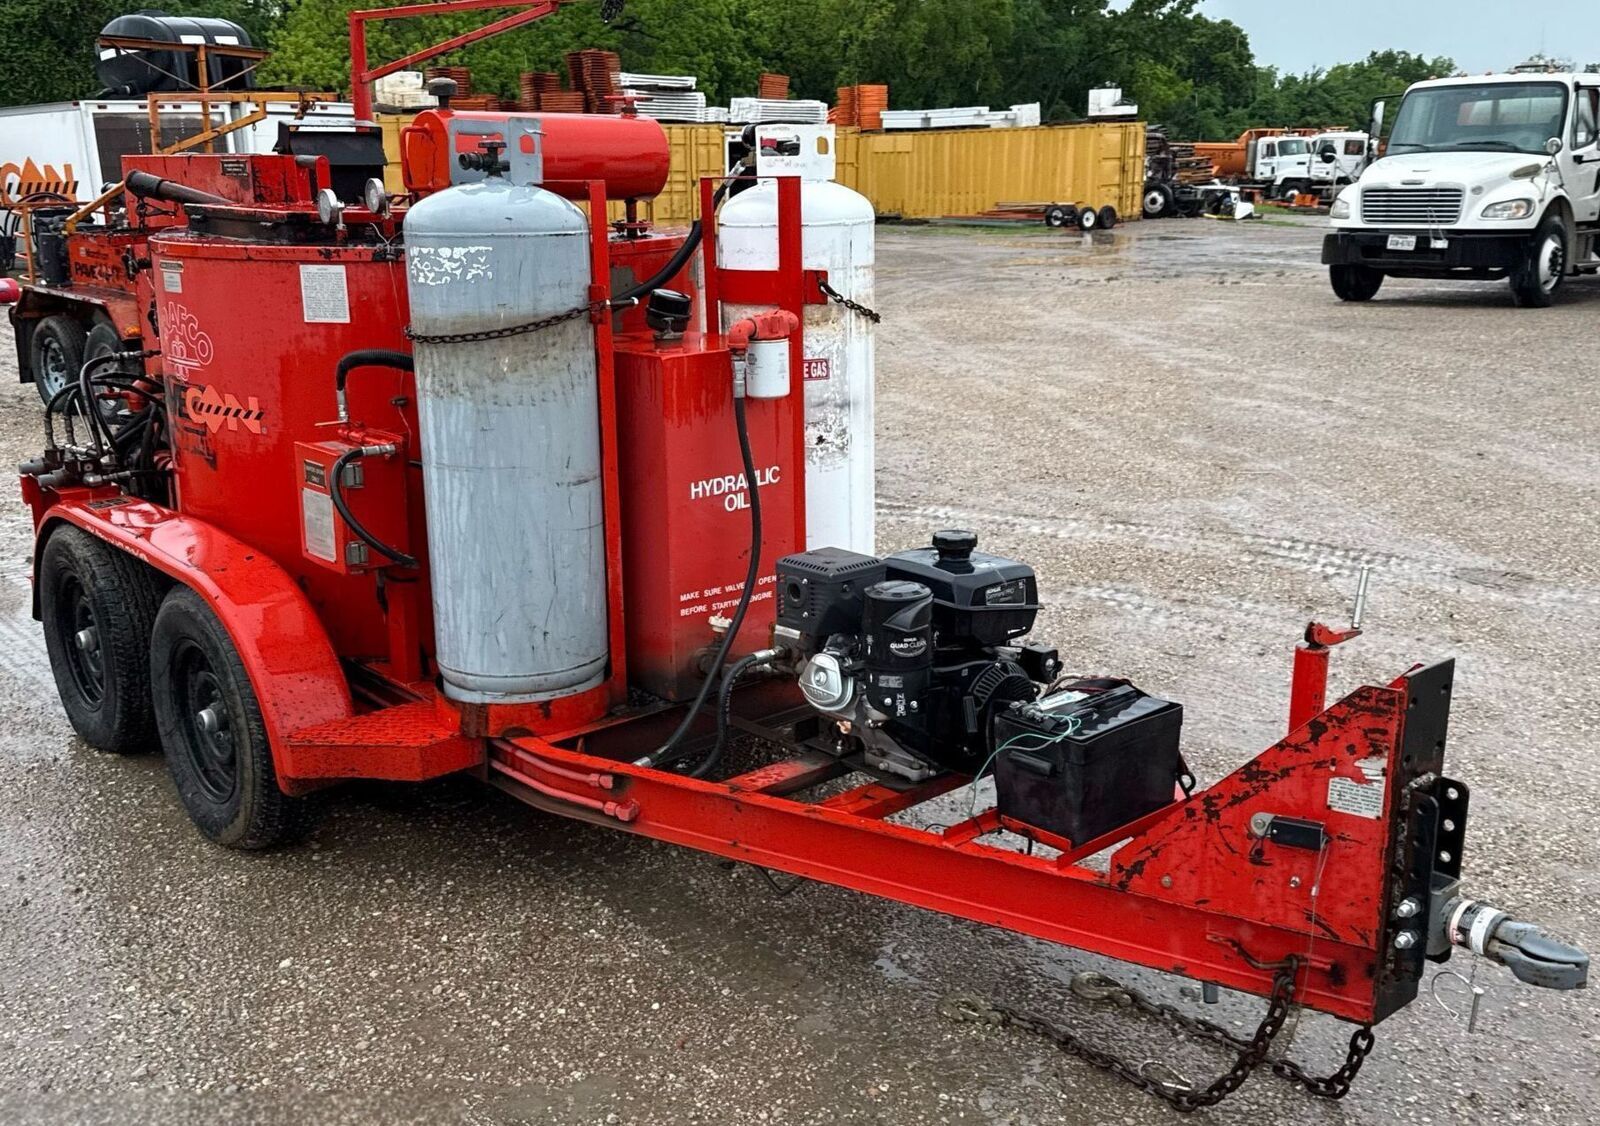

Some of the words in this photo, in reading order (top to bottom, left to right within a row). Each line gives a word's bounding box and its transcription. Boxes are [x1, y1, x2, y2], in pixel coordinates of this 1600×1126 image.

[811, 361, 827, 377] GAS
[691, 466, 781, 499] HYDRALIC
[724, 492, 750, 512] OIL
[680, 591, 700, 601] MAKE
[704, 587, 722, 597] SURE
[725, 582, 745, 592] VALVE
[758, 575, 777, 585] OPEN
[680, 605, 707, 616] BEFORE
[712, 598, 741, 610] STARTIN
